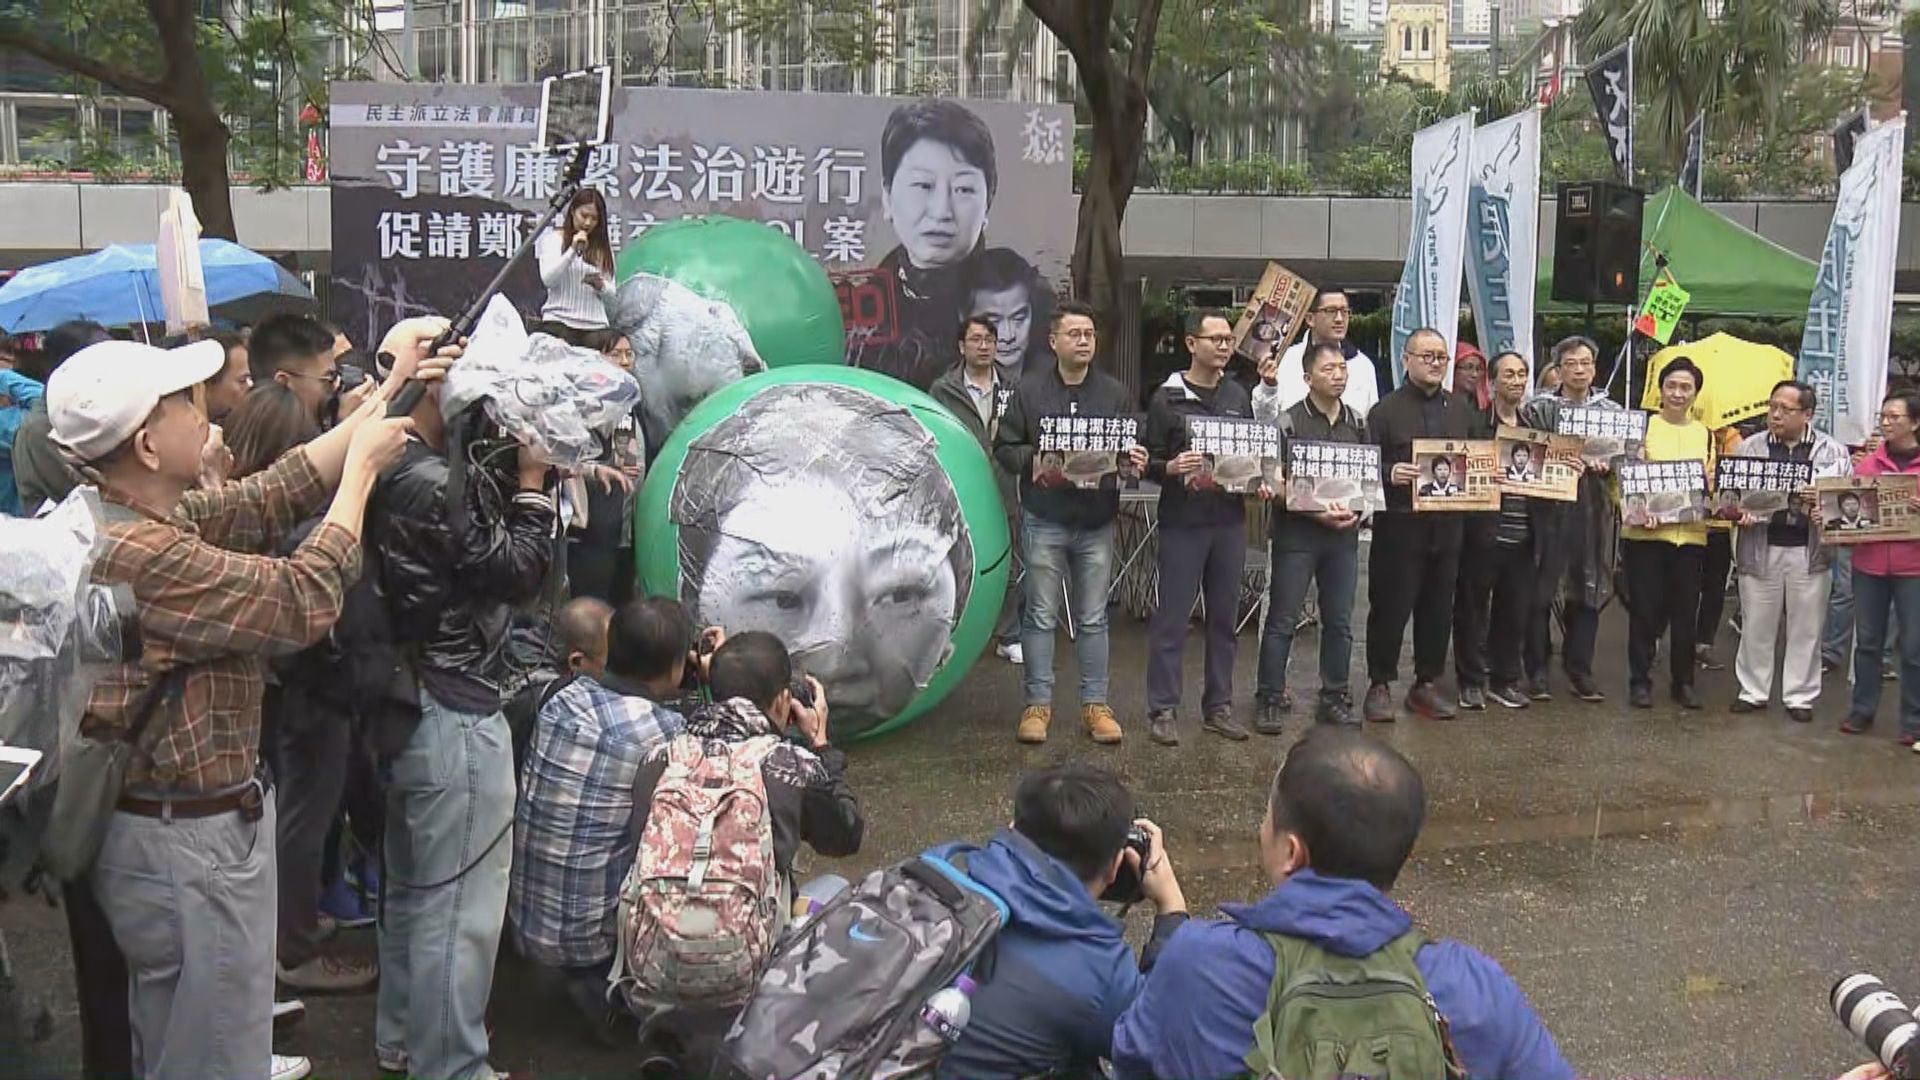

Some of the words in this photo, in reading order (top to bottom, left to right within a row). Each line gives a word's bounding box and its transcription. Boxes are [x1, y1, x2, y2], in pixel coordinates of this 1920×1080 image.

[366, 103, 537, 123] 民主派立法會議員
[376, 140, 866, 204] 守護廉潔法治遊行
